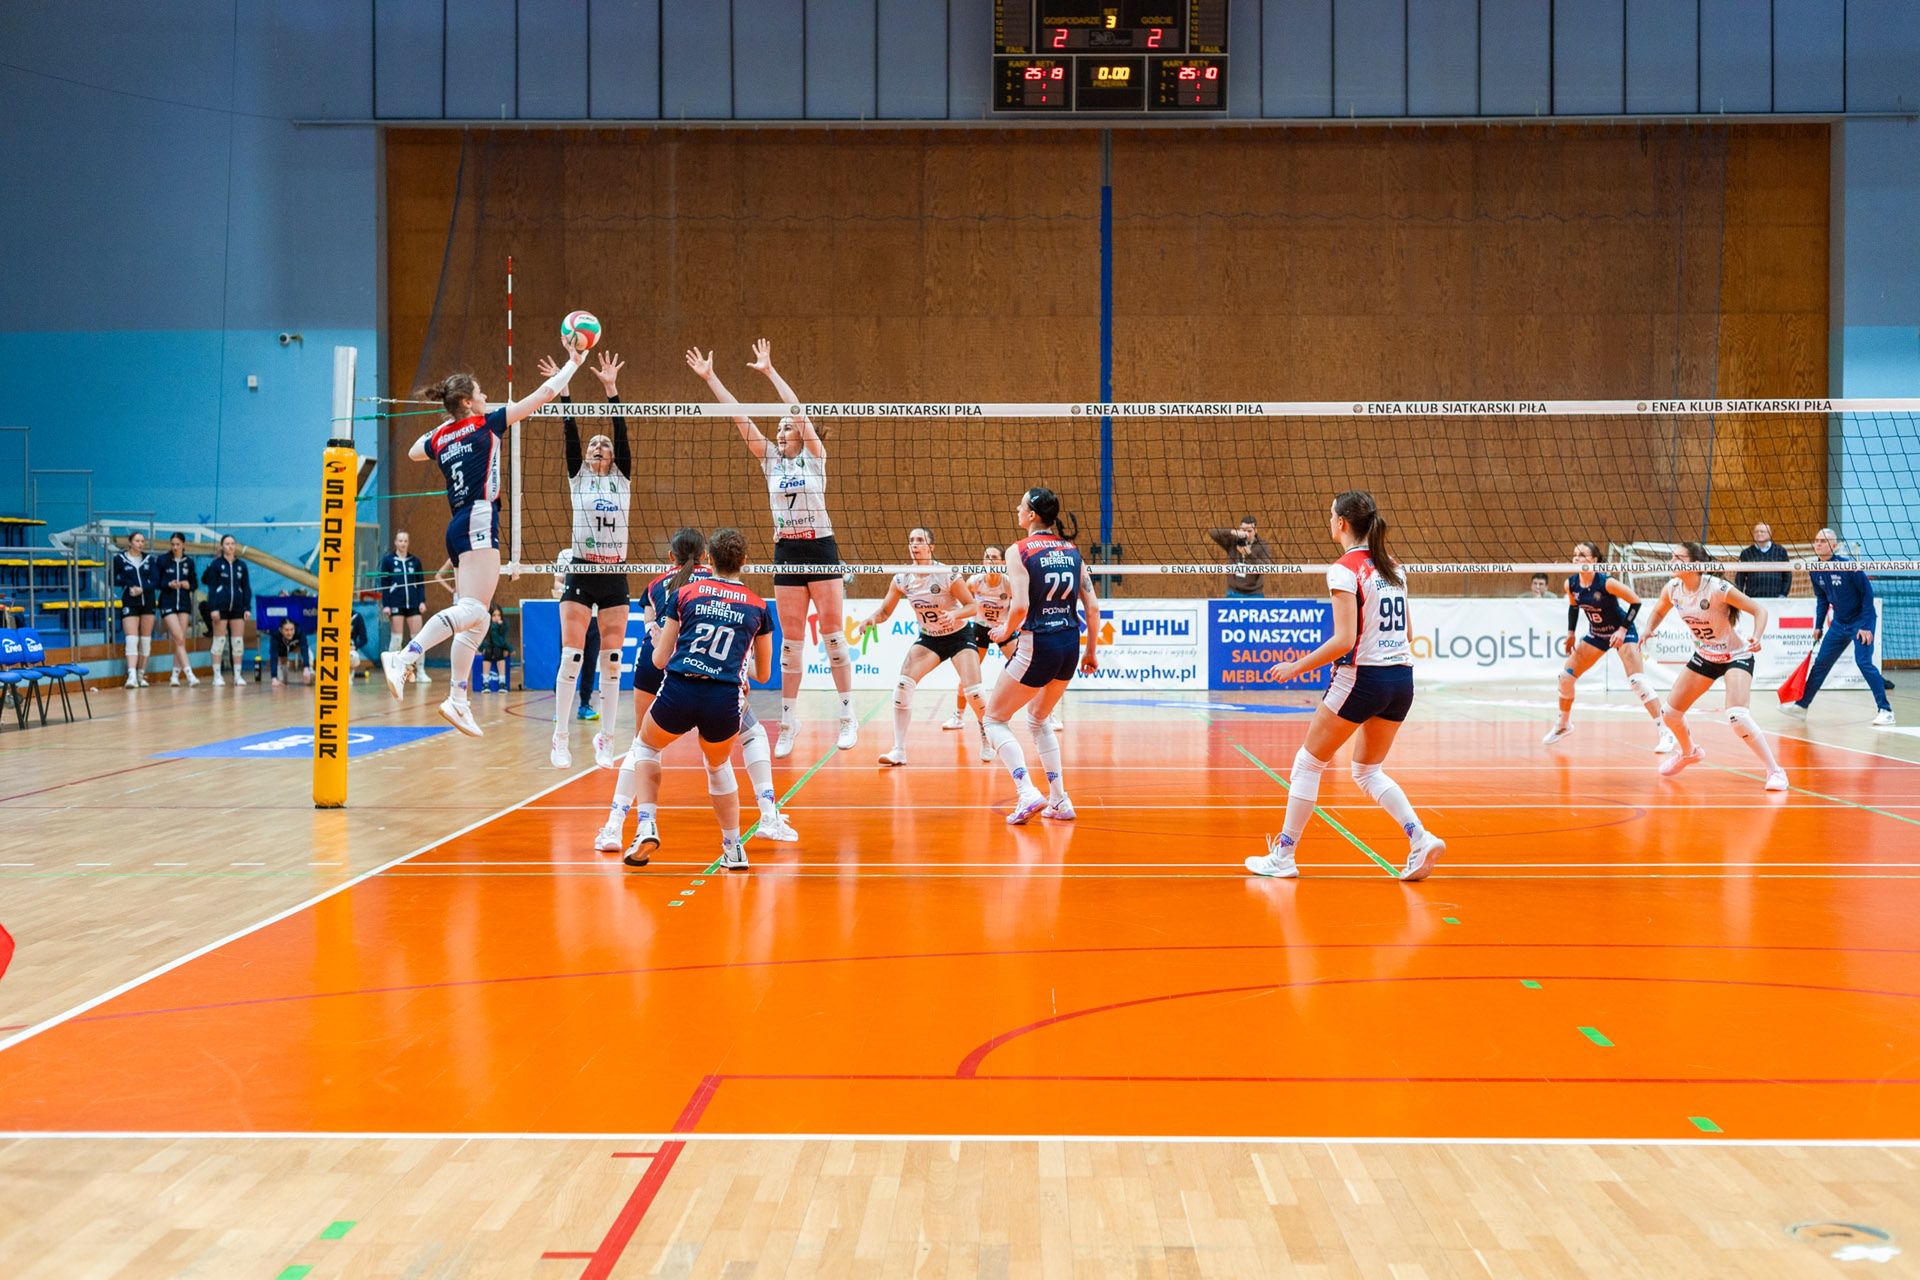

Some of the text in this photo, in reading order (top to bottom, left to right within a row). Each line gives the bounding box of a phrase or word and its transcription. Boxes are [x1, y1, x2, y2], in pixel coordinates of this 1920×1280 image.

[1105, 16, 1116, 28] 3
[1053, 29, 1068, 48] 2
[1147, 28, 1162, 48] 2
[1098, 67, 1130, 80] 0.00
[533, 405, 702, 415] NEA KLUB SIATKARSKI PIŁA
[806, 405, 982, 415] ENEA KLUB SIATKARSKI PIŁA
[1086, 404, 1263, 415] ENEA KLUB SIATKARSKI PIŁA
[1368, 403, 1547, 413] ENEA KLUB SIATKARSKI PIŁA
[1652, 401, 1832, 412] ENEA KLUB SIATKARSKI PIŁA
[451, 461, 464, 491] 5
[779, 479, 806, 488] Enea
[595, 503, 618, 512] Enea
[785, 493, 797, 509] 7
[595, 516, 615, 532] 14
[786, 514, 815, 527] eneris
[1040, 556, 1075, 568] ENERGETYK
[698, 585, 747, 602] GREJMAN
[1044, 572, 1074, 601] 77
[710, 600, 731, 610] ENEA
[319, 479, 344, 759] SPORT TRANSFER
[695, 604, 744, 624] ENERGETYK
[920, 611, 938, 623] 19
[1218, 609, 1324, 623] ZAPRASZAMY
[1379, 597, 1405, 631] 99
[1587, 612, 1603, 623] 18
[1122, 620, 1189, 635] WPHW
[689, 622, 735, 661] 20
[1221, 629, 1321, 643] DO NASZYCH
[1410, 628, 1568, 667] aLogistic
[1656, 644, 1690, 654] Sportu
[1232, 647, 1311, 663] SALONÓW
[855, 664, 879, 674] Piła
[1077, 664, 1196, 682] www.wphw.pl
